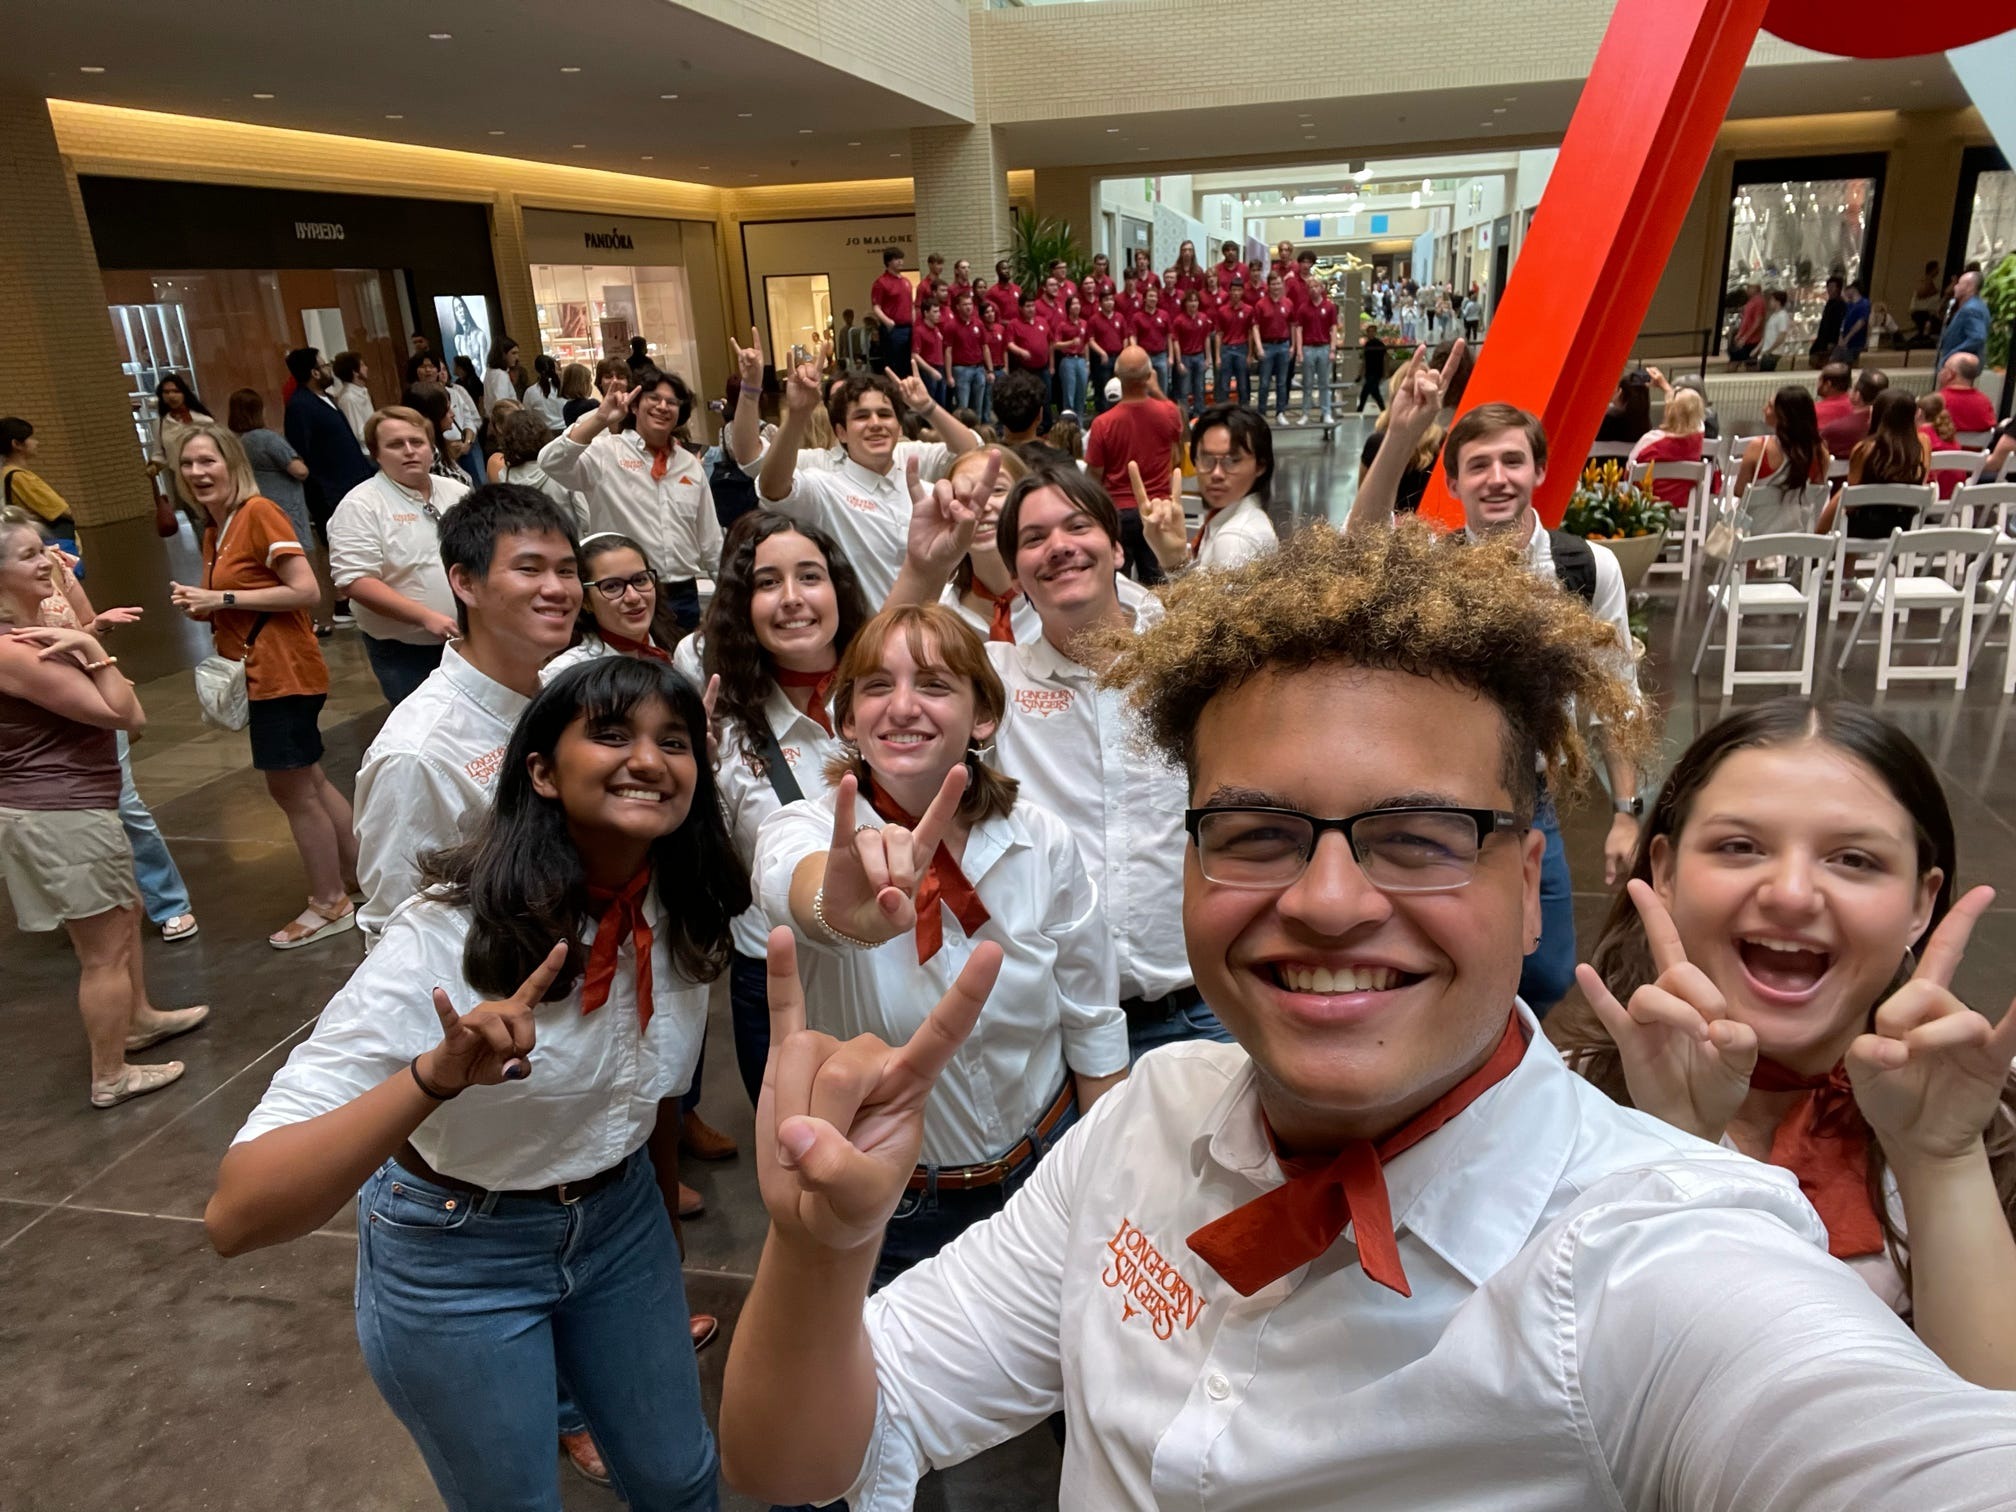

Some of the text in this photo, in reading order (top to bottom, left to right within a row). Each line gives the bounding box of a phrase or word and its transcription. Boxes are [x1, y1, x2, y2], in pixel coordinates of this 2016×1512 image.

[846, 234, 912, 246] JO MALONE
[1015, 688, 1076, 703] LONGHORN
[1020, 699, 1070, 714] SINGERS
[1107, 1218, 1207, 1330] LONGHORN
[1102, 1251, 1179, 1341] SINGERS
